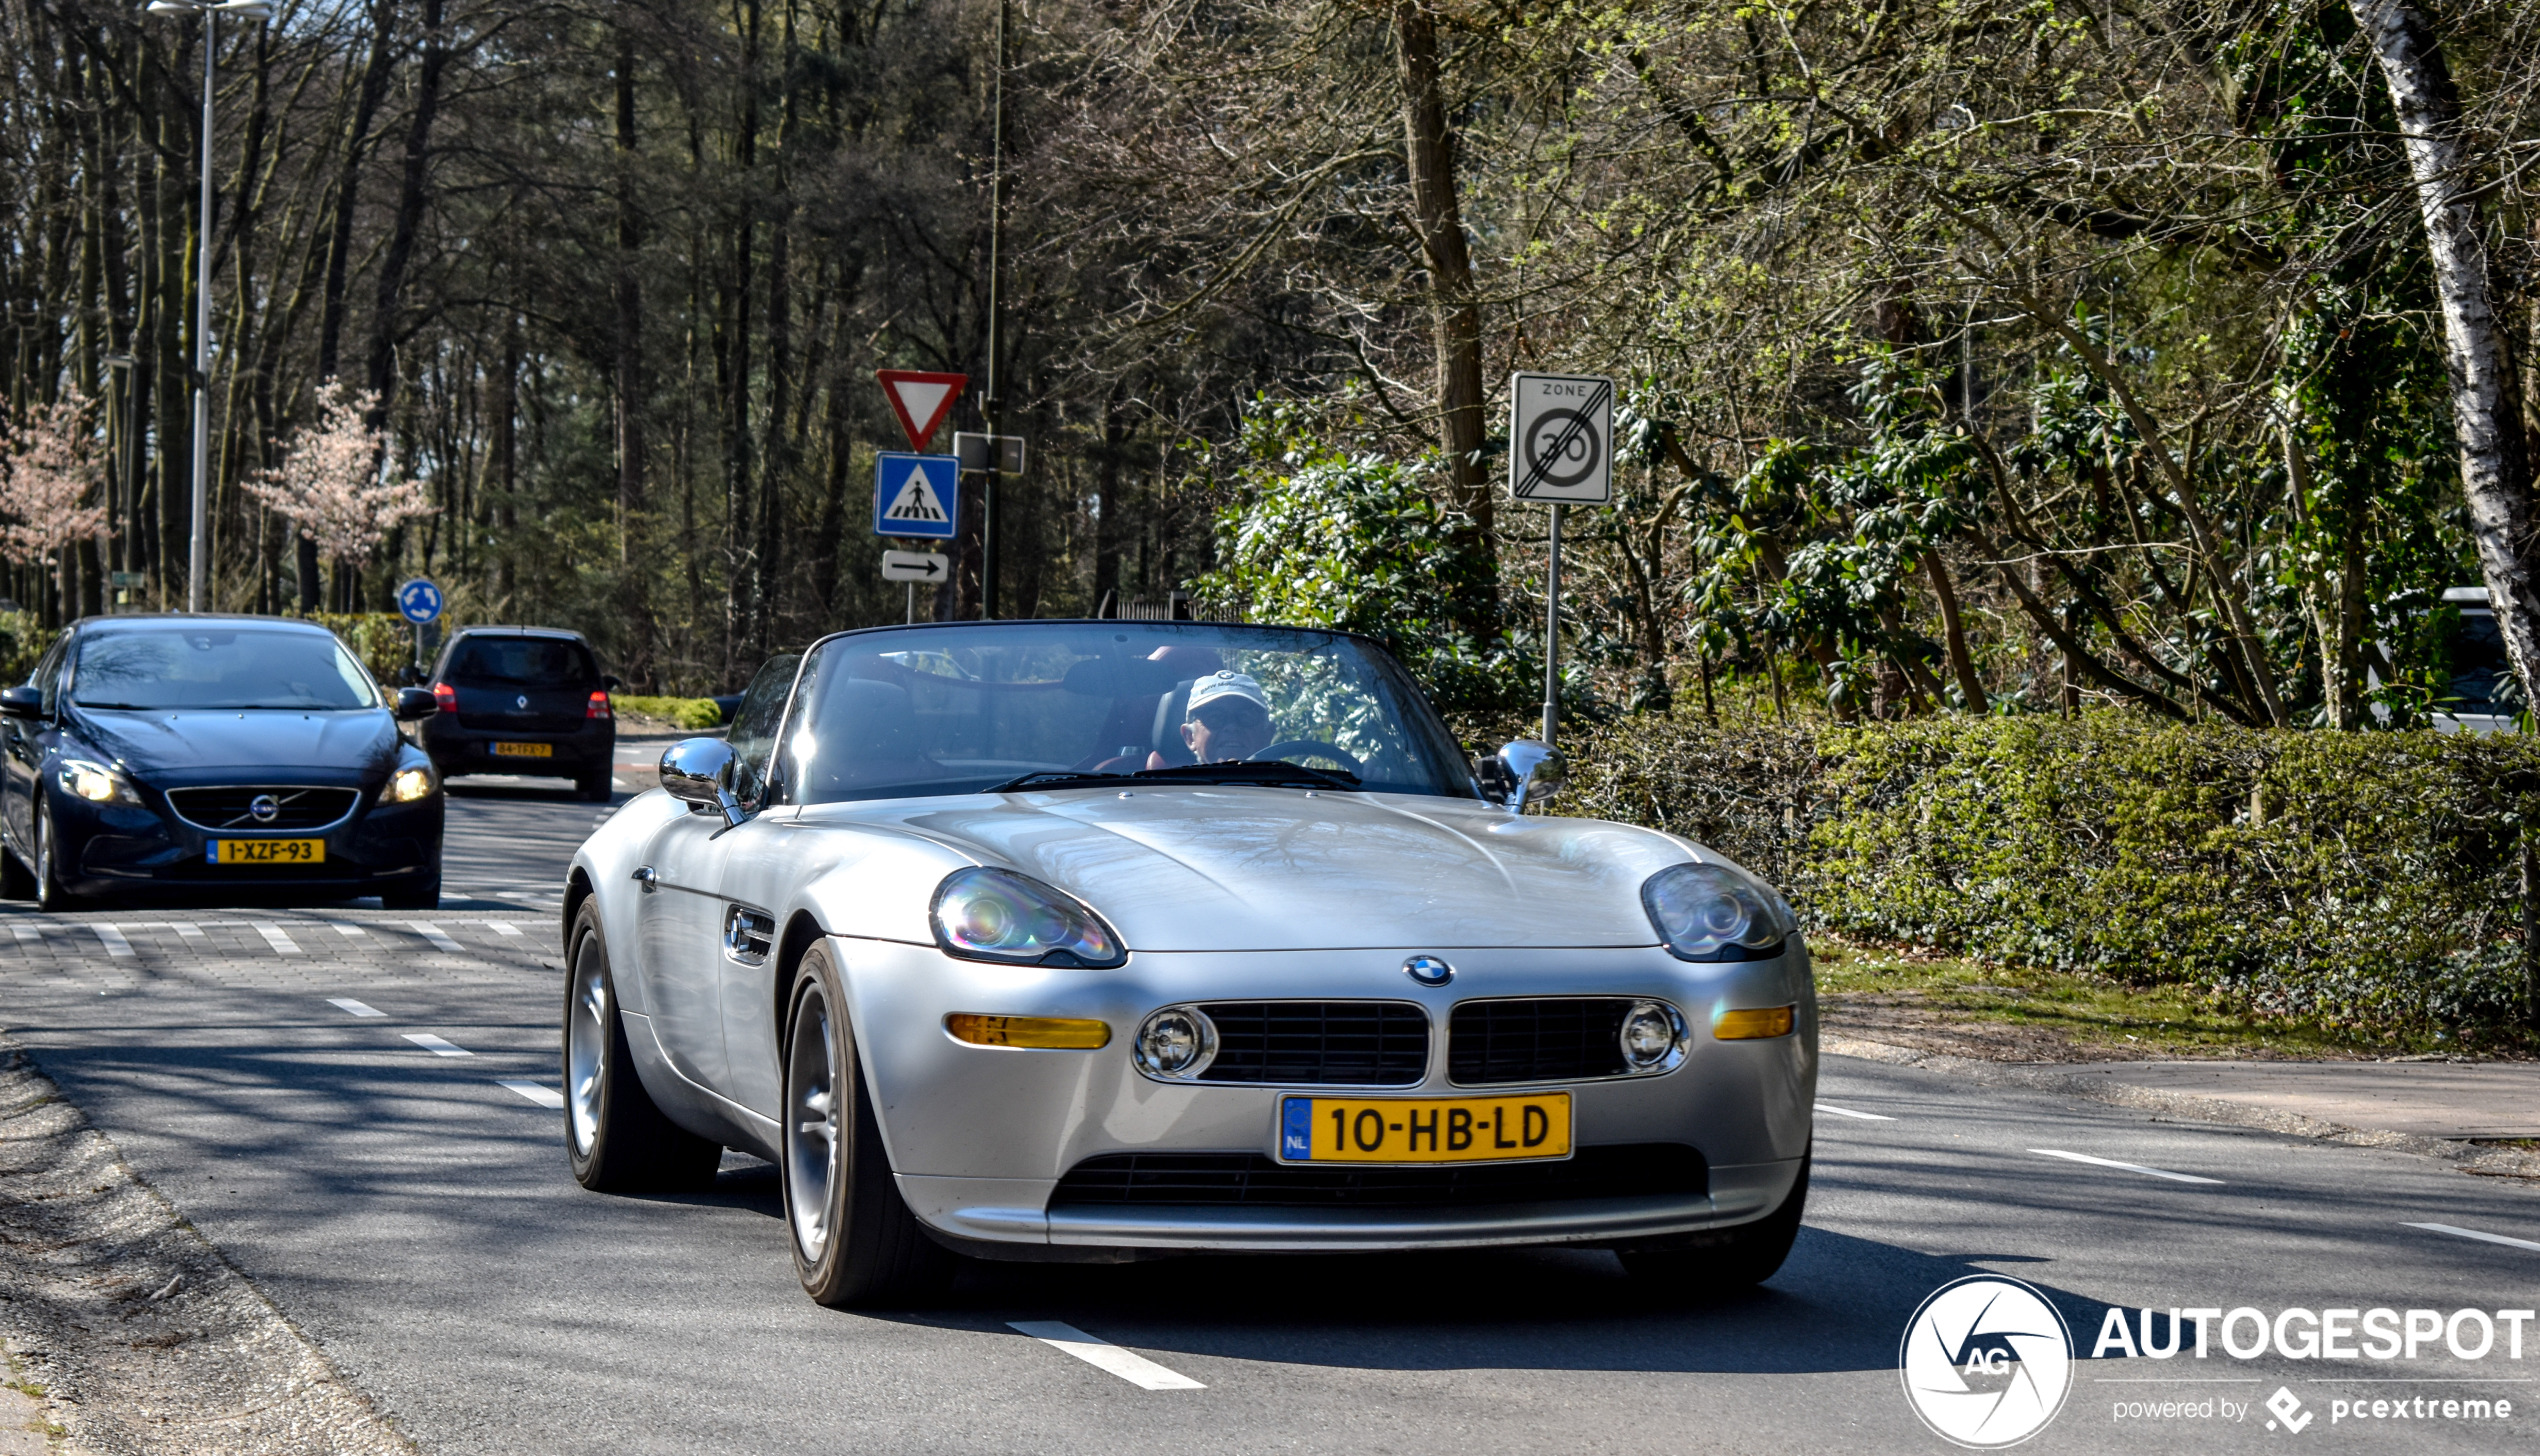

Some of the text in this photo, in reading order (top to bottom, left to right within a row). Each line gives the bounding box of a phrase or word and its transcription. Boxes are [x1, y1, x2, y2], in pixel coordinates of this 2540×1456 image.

[1542, 383, 1587, 397] ZONE
[228, 842, 313, 860] 1-XZF-93
[1331, 1104, 1549, 1152] 10-HB-LD
[1286, 1135, 1308, 1150] NL
